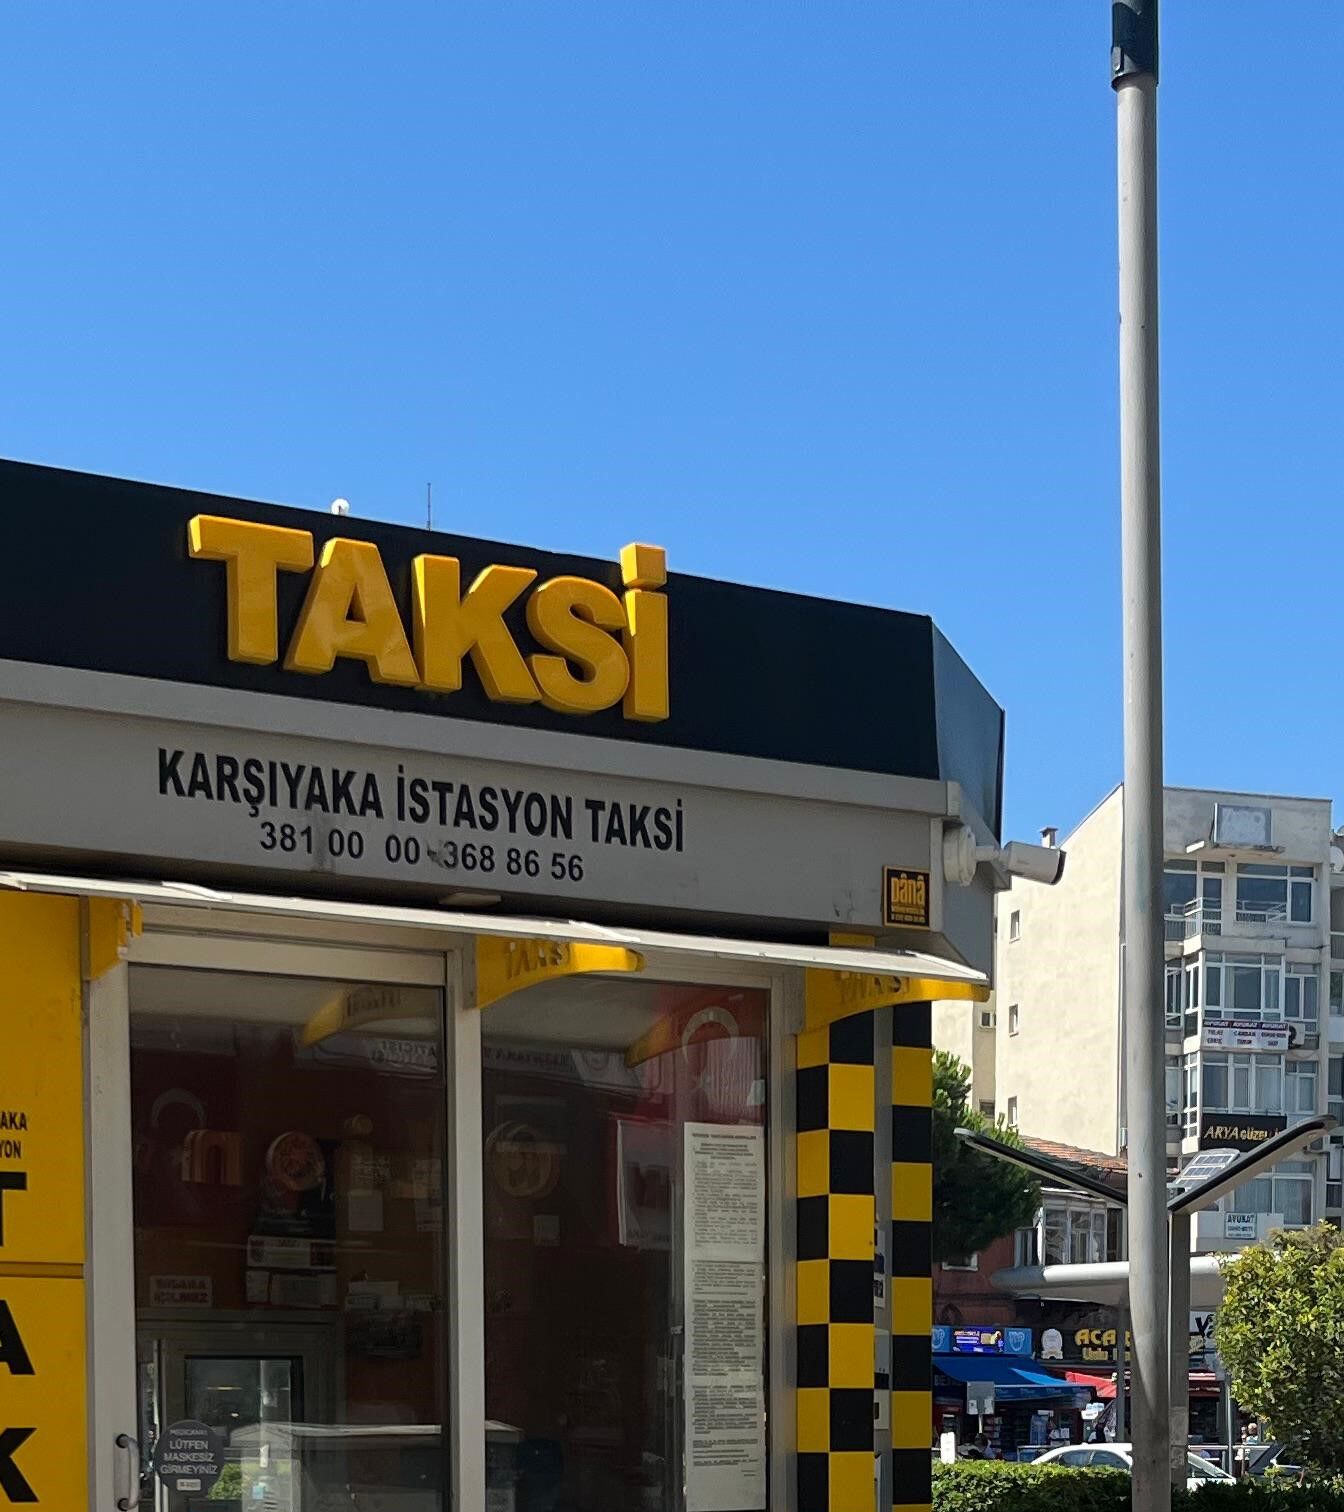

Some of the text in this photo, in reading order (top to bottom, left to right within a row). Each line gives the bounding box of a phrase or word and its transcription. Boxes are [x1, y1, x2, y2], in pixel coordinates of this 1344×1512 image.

[187, 513, 670, 723] TAKSİ
[157, 748, 684, 852] KARŞIYAKA İSTASYON TAKSİ
[260, 821, 313, 855] 381
[328, 828, 364, 859] 00
[507, 848, 540, 878] 86
[551, 853, 584, 882] 56
[1203, 1125, 1239, 1141] ARYA
[163, 1452, 215, 1462] MASKESİZ
[169, 1438, 209, 1450] LÜTFEN
